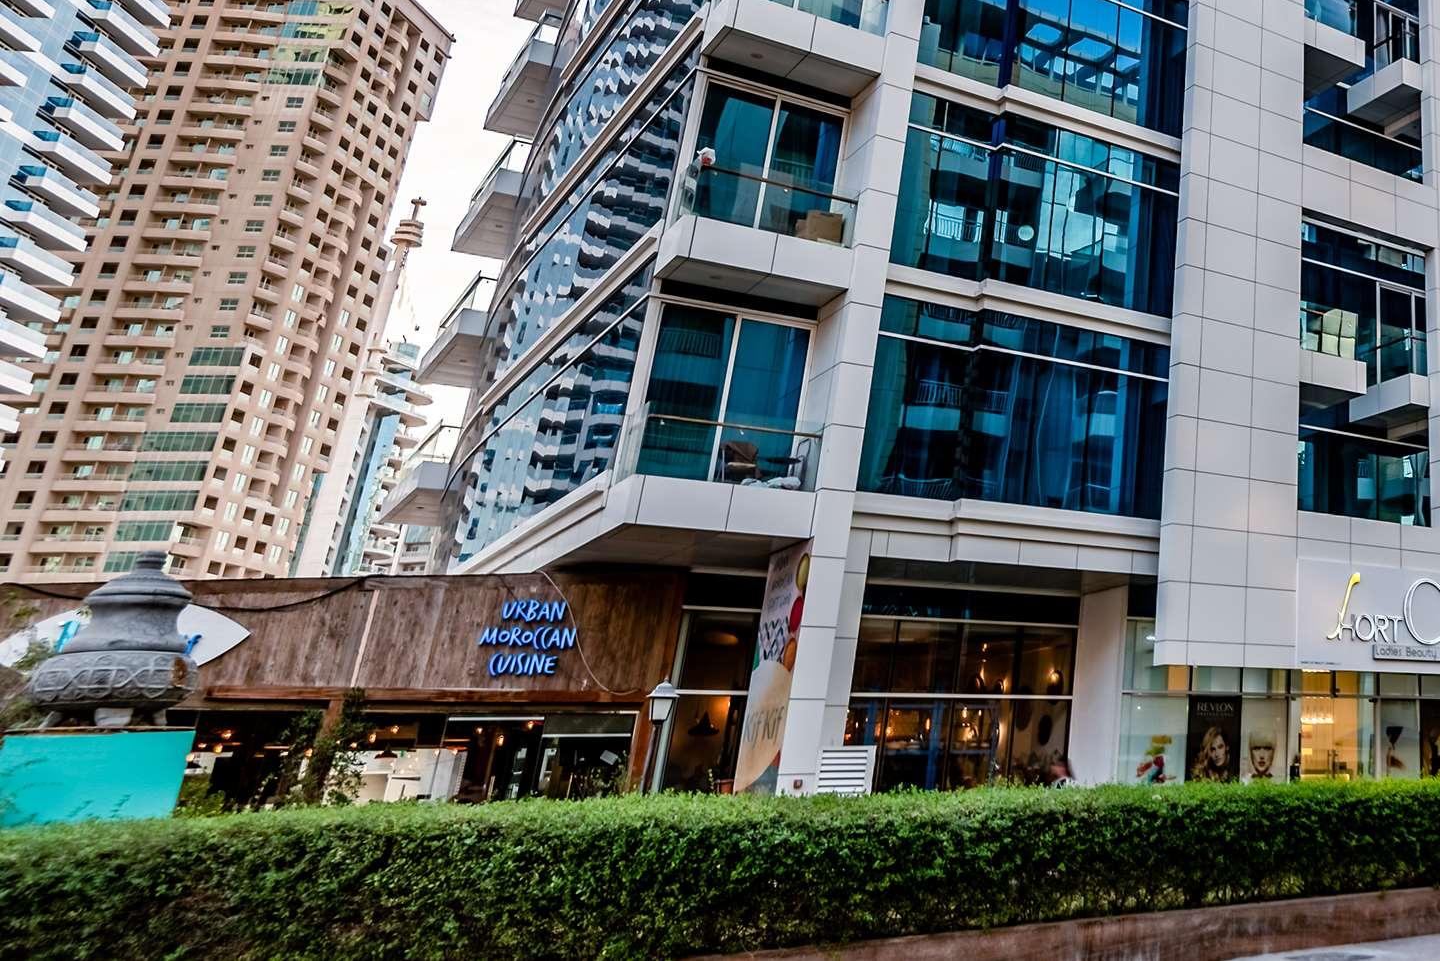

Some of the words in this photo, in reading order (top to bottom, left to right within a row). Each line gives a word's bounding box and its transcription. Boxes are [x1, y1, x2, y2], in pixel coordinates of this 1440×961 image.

[502, 600, 567, 622] URBAN
[479, 626, 577, 649] MOROCCAN
[487, 652, 558, 676] CUISINE
[1376, 645, 1402, 657] Ladies
[1406, 646, 1437, 661] Beauty
[1197, 701, 1234, 712] REVLON
